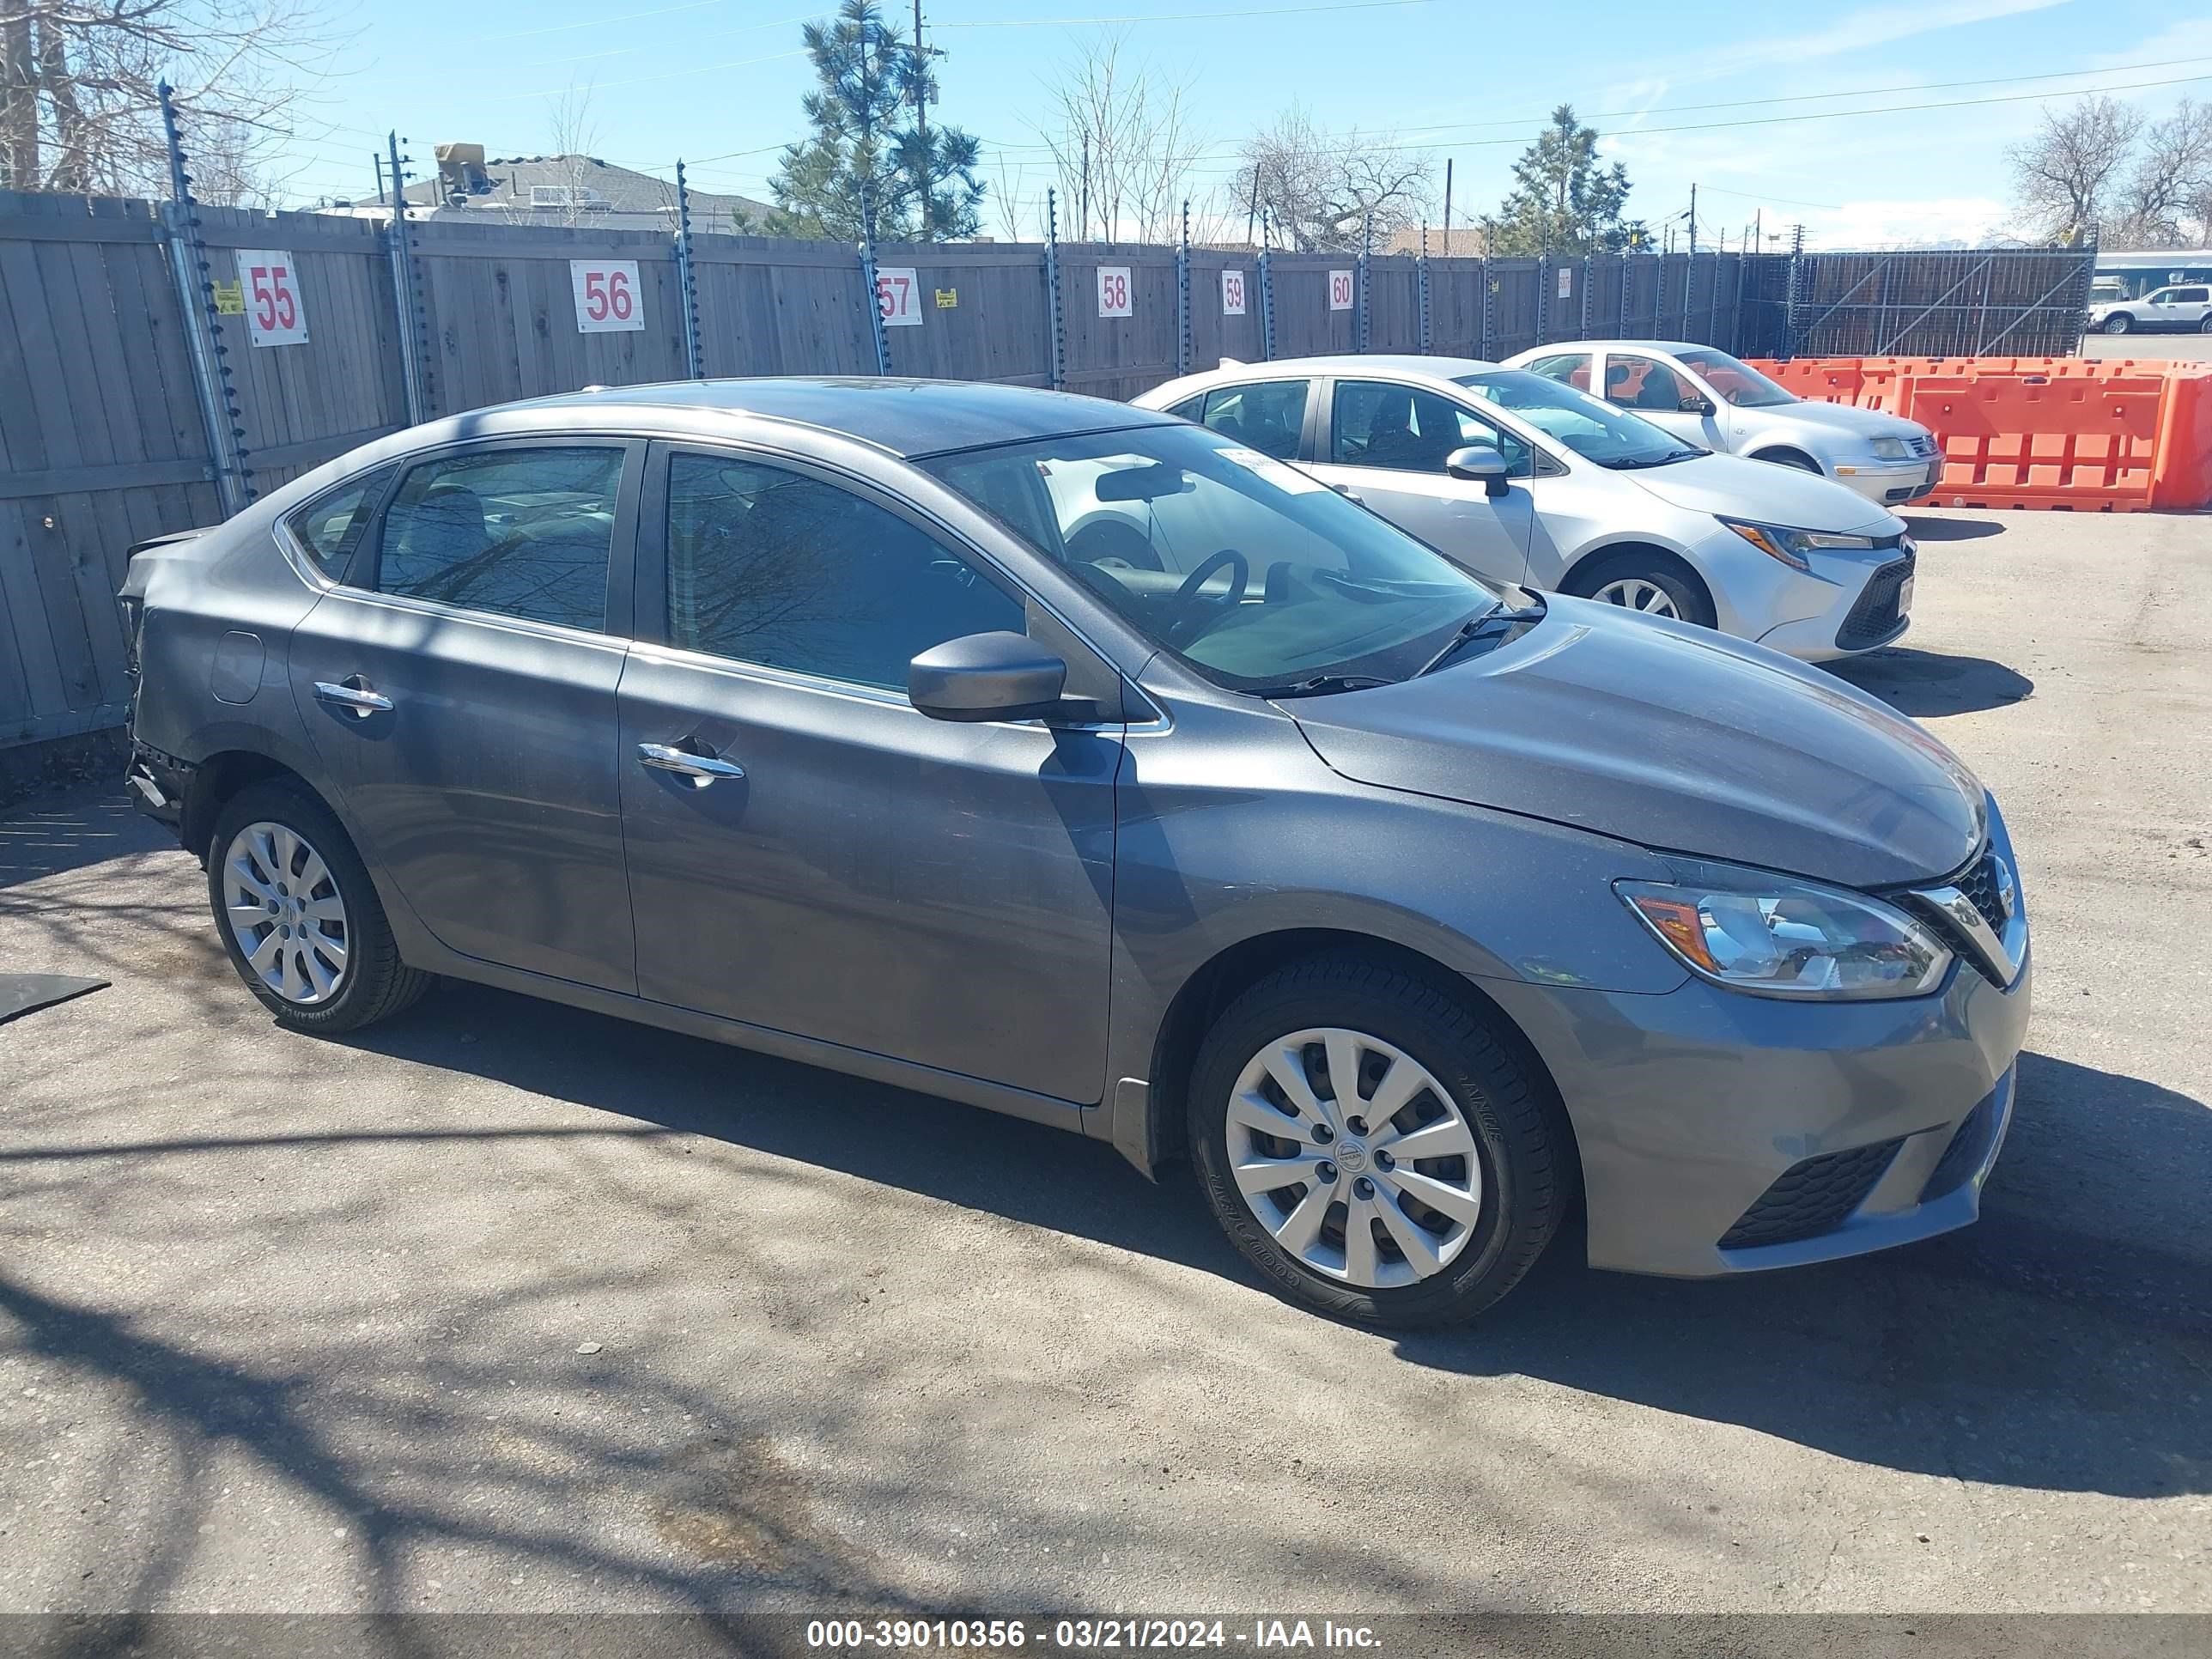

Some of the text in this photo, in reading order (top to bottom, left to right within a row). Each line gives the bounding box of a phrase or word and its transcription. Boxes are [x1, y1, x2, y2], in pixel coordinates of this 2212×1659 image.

[250, 267, 295, 331] 55
[586, 271, 632, 321] 56
[878, 277, 910, 317] 57
[1104, 275, 1127, 309] 58
[1226, 278, 1242, 307] 59
[1334, 276, 1350, 303] 60
